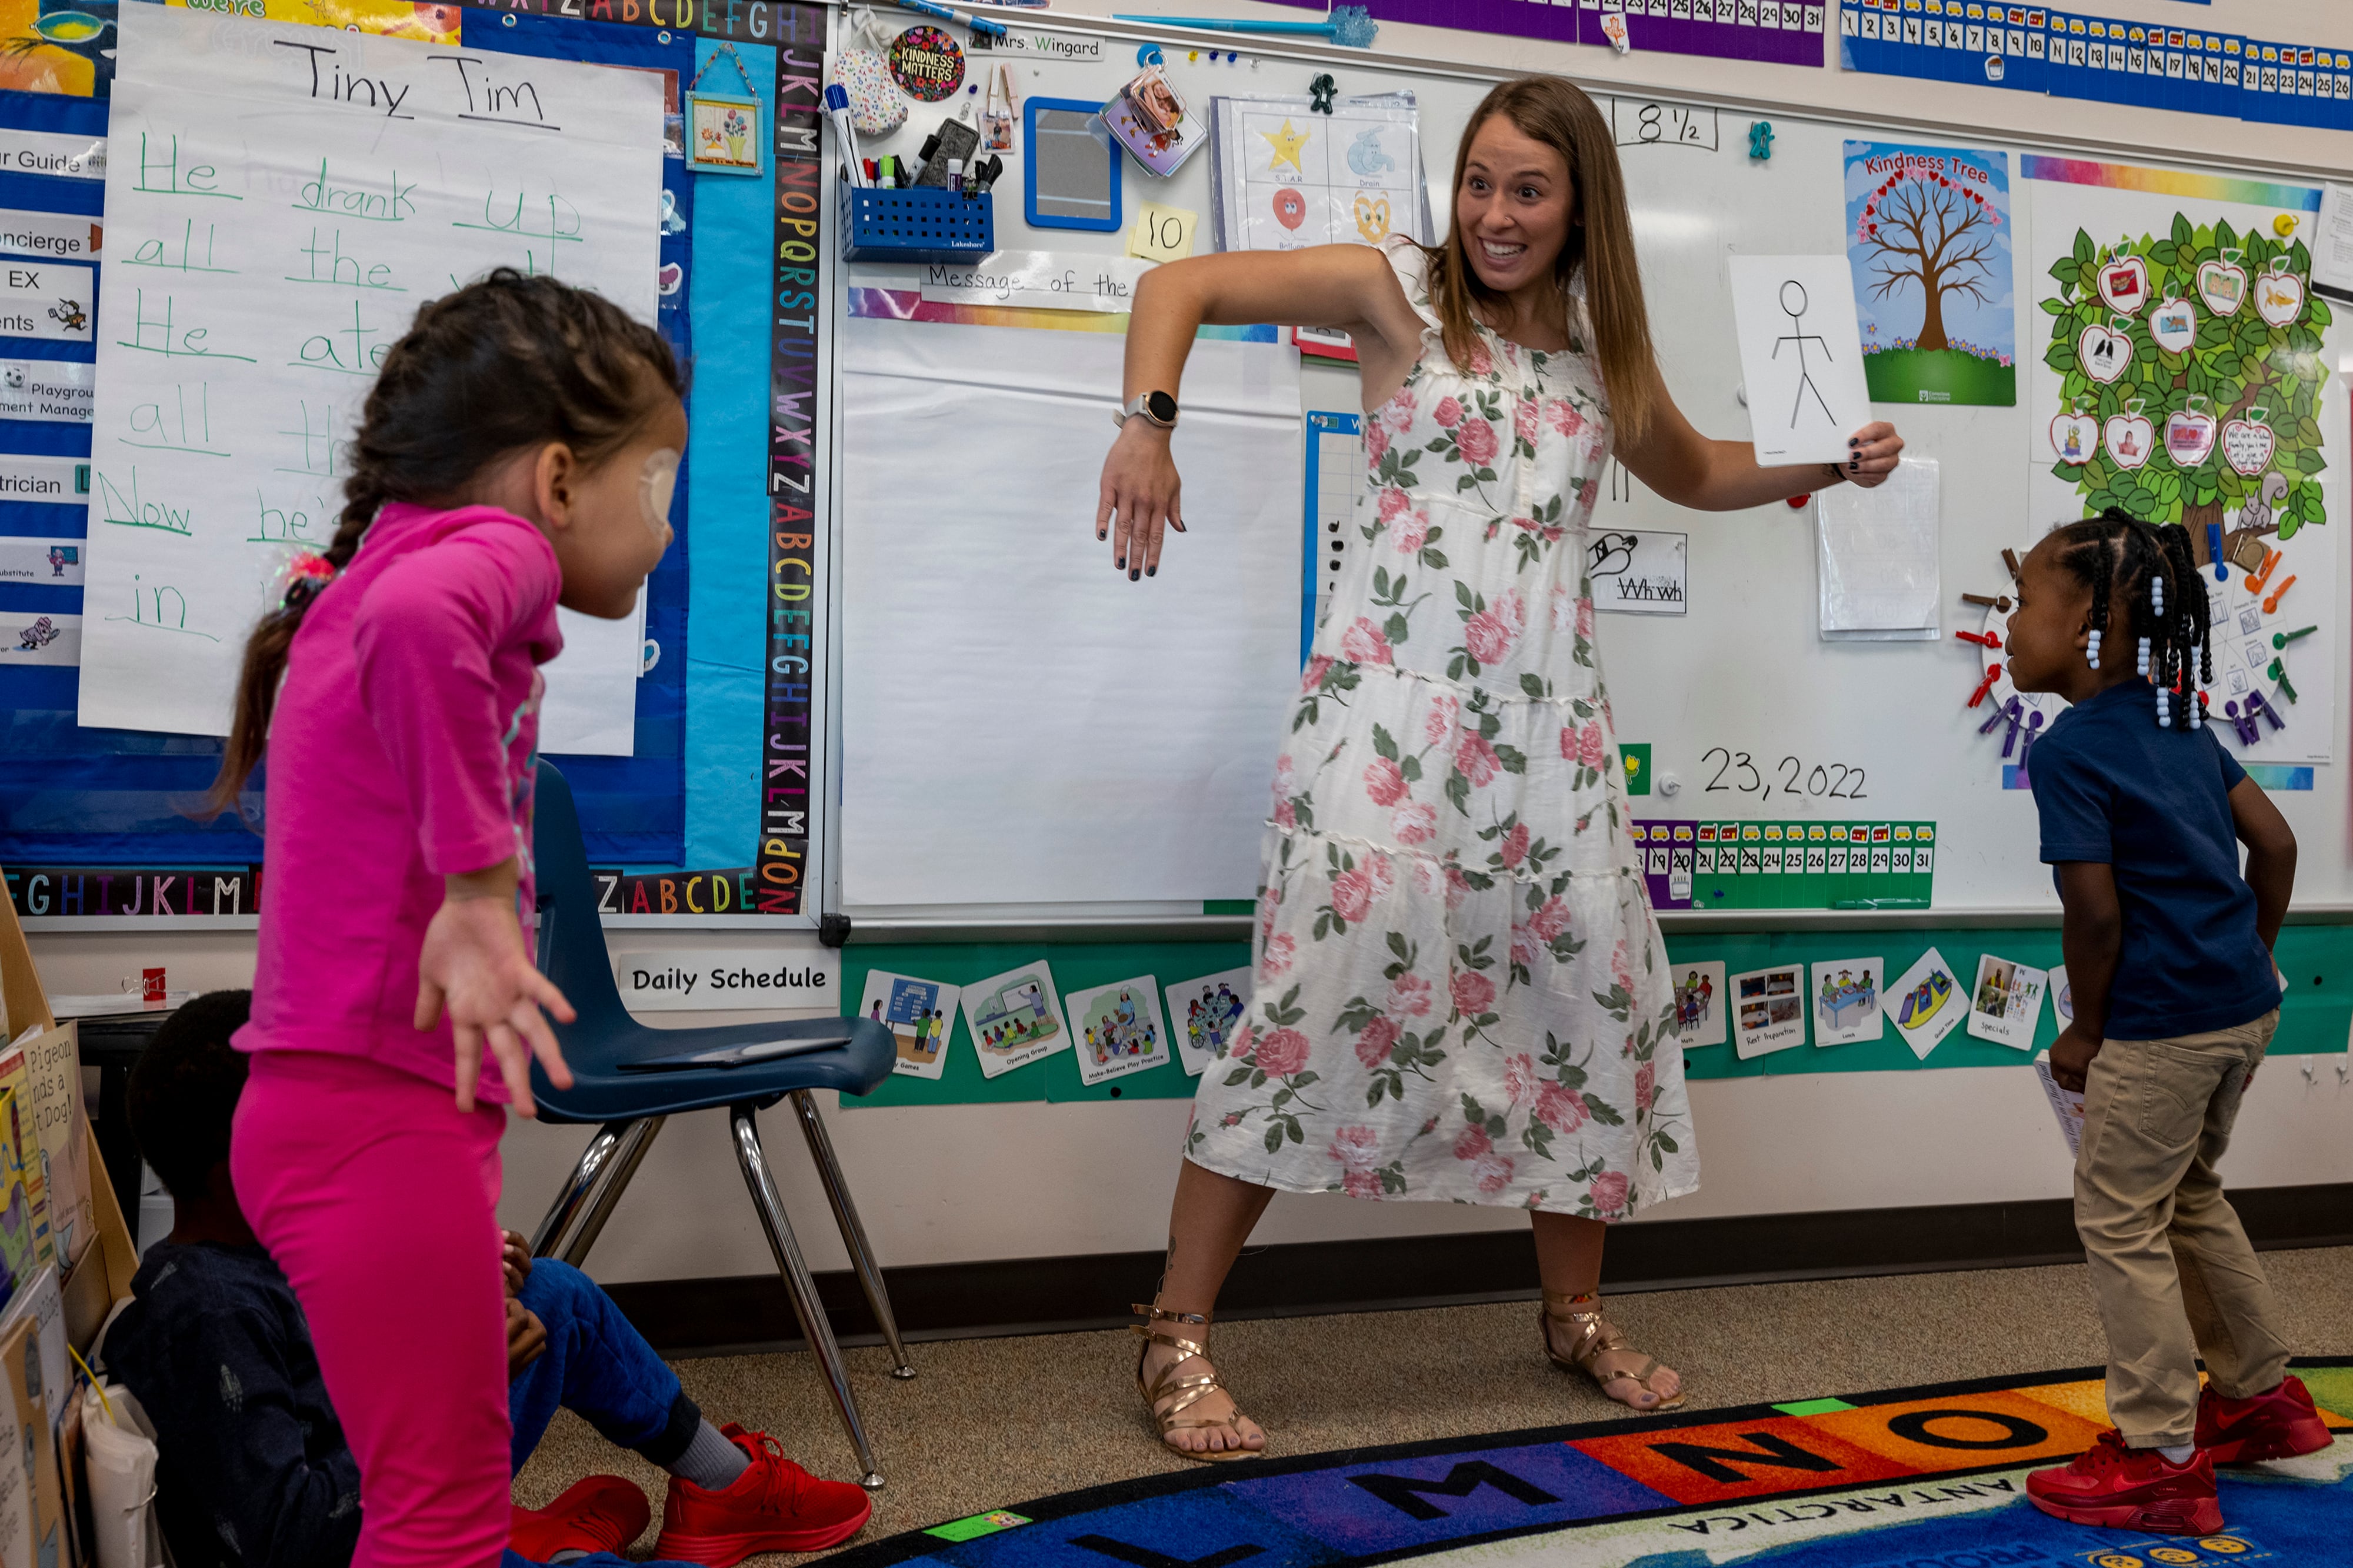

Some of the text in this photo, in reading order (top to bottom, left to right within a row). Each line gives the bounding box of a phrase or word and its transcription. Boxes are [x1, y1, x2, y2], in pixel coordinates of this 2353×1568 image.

[1718, 4, 1734, 16] 27
[1740, 6, 1756, 19] 28
[1762, 8, 1778, 22] 29
[1784, 9, 1800, 24] 30
[1807, 12, 1819, 26] 31
[902, 46, 955, 69] KINDNESS
[995, 35, 1099, 56] Mrs. Wingard
[1867, 19, 1874, 32] 2
[1887, 22, 1895, 34] 3
[1908, 25, 1916, 38] 4
[1929, 27, 1937, 39] 5
[1950, 29, 1958, 42] 6
[1971, 32, 1978, 44] 7
[1992, 34, 1999, 46] 8
[2012, 37, 2019, 50] 9
[2031, 39, 2042, 52] 10
[2071, 46, 2082, 59] 12
[2111, 52, 2122, 64] 14
[2224, 65, 2238, 79] 20
[2246, 71, 2256, 84] 21
[2262, 74, 2276, 86] 22
[2281, 75, 2294, 88] 23
[2299, 77, 2312, 89] 24
[2317, 79, 2331, 92] 25
[2336, 81, 2349, 94] 26
[274, 40, 414, 119] Tiny
[427, 56, 543, 121] Tim
[901, 61, 953, 82] MATTERS
[18, 151, 81, 173] Guide
[141, 132, 218, 193] He
[301, 157, 418, 218] drank
[1864, 151, 1989, 185] Kindness Tree
[1359, 179, 1379, 188] Drain
[0, 231, 81, 256] ncierge
[1149, 211, 1182, 249] 10
[135, 219, 214, 272] all
[301, 227, 391, 286] the
[9, 270, 40, 289] EX
[929, 265, 1129, 300] Message of the
[136, 288, 208, 358] He
[130, 382, 209, 443] all
[98, 465, 191, 531] Now
[134, 573, 186, 629] in
[1619, 577, 1682, 601] Wh wh
[1652, 854, 1666, 868] 19
[1673, 854, 1690, 868] 20
[1699, 854, 1712, 867] 21
[1719, 855, 1735, 867] 22
[1742, 854, 1757, 867] 23
[1764, 854, 1781, 867] 24
[1786, 854, 1802, 867] 25
[1808, 854, 1824, 867] 26
[1830, 854, 1846, 867] 27
[1851, 854, 1867, 867] 28
[1872, 854, 1888, 867] 29
[1894, 854, 1910, 867] 30
[1917, 854, 1928, 867] 31
[632, 967, 826, 995] Daily Schedule
[1981, 1021, 2010, 1036] Specials
[31, 1039, 71, 1073] Pigeon
[1006, 1045, 1048, 1066] Opening Group
[1088, 1054, 1164, 1080] Make-Believe Play Practice
[58, 1073, 65, 1092] a
[45, 1093, 72, 1129] Dog!
[1667, 1477, 2017, 1534] ANTARCTICA
